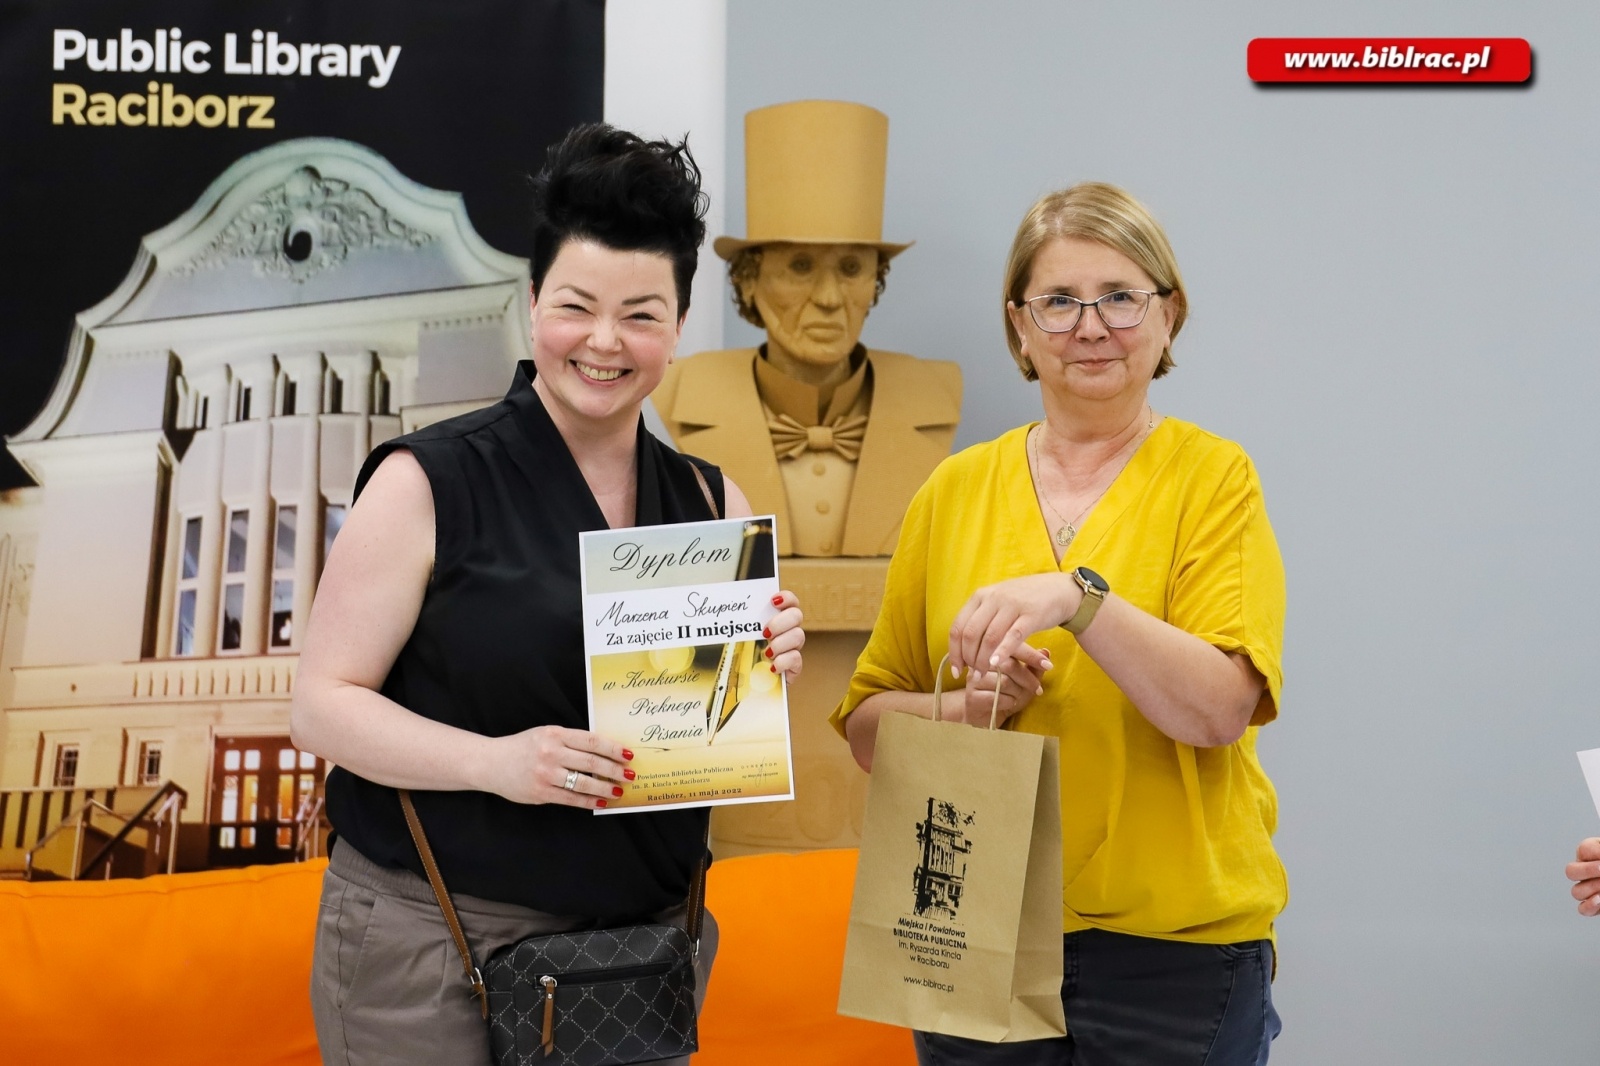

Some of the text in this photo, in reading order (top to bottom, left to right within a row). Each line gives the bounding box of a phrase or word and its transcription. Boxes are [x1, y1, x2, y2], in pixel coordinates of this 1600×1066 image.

[53, 27, 402, 88] Public Library
[52, 80, 275, 129] Raciborz
[610, 537, 732, 579] Dyplom
[595, 591, 751, 627] Marzena Skupień
[606, 620, 763, 646] Za zajęcie II miejsca
[602, 668, 701, 691] w Konkursie
[628, 696, 701, 717] Pięknego
[640, 724, 704, 743] Pisania
[637, 766, 734, 781] Powiatowa Biblioteka Publiczna
[680, 777, 711, 785] Raciborzu
[647, 792, 687, 802] Racibórz,
[699, 788, 719, 797] maja
[897, 917, 924, 929] Miejska
[929, 923, 966, 938] Powiatowa
[893, 928, 968, 950] BIBLIOTEKA PUBLICZNA
[909, 942, 940, 956] Ryszarda
[917, 954, 950, 969] Raciborzu
[903, 976, 955, 993] www.biblrac.pl
